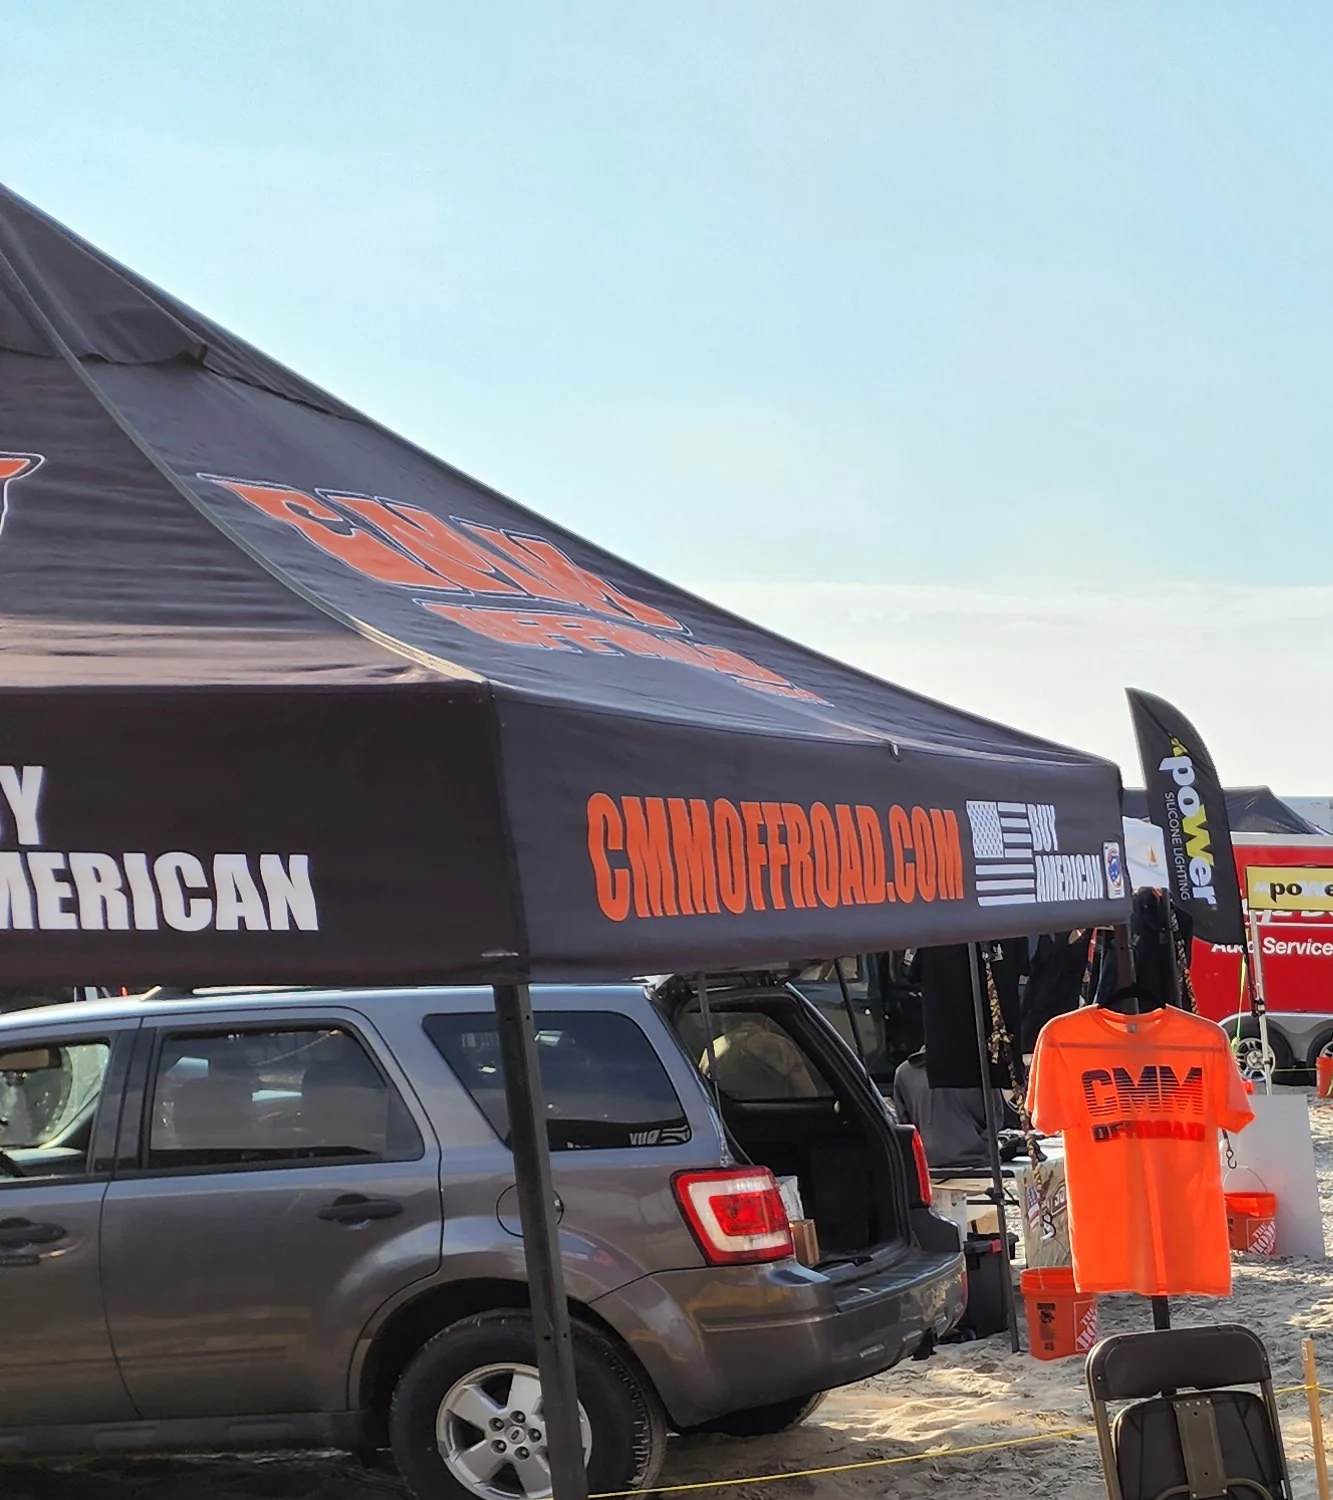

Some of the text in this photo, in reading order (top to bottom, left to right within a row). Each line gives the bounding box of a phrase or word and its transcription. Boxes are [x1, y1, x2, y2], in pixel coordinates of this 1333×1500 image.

[1027, 803, 1059, 851] BUY
[1164, 790, 1190, 901] SILICONE LIGHTING
[586, 792, 965, 922] CMMOFFROAD.COM
[1035, 853, 1104, 902] AMERICAN
[0, 851, 319, 932] MERICAN
[1263, 936, 1333, 956] Service
[1081, 1065, 1204, 1117] CMM
[1091, 1120, 1206, 1143] OFFROAD
